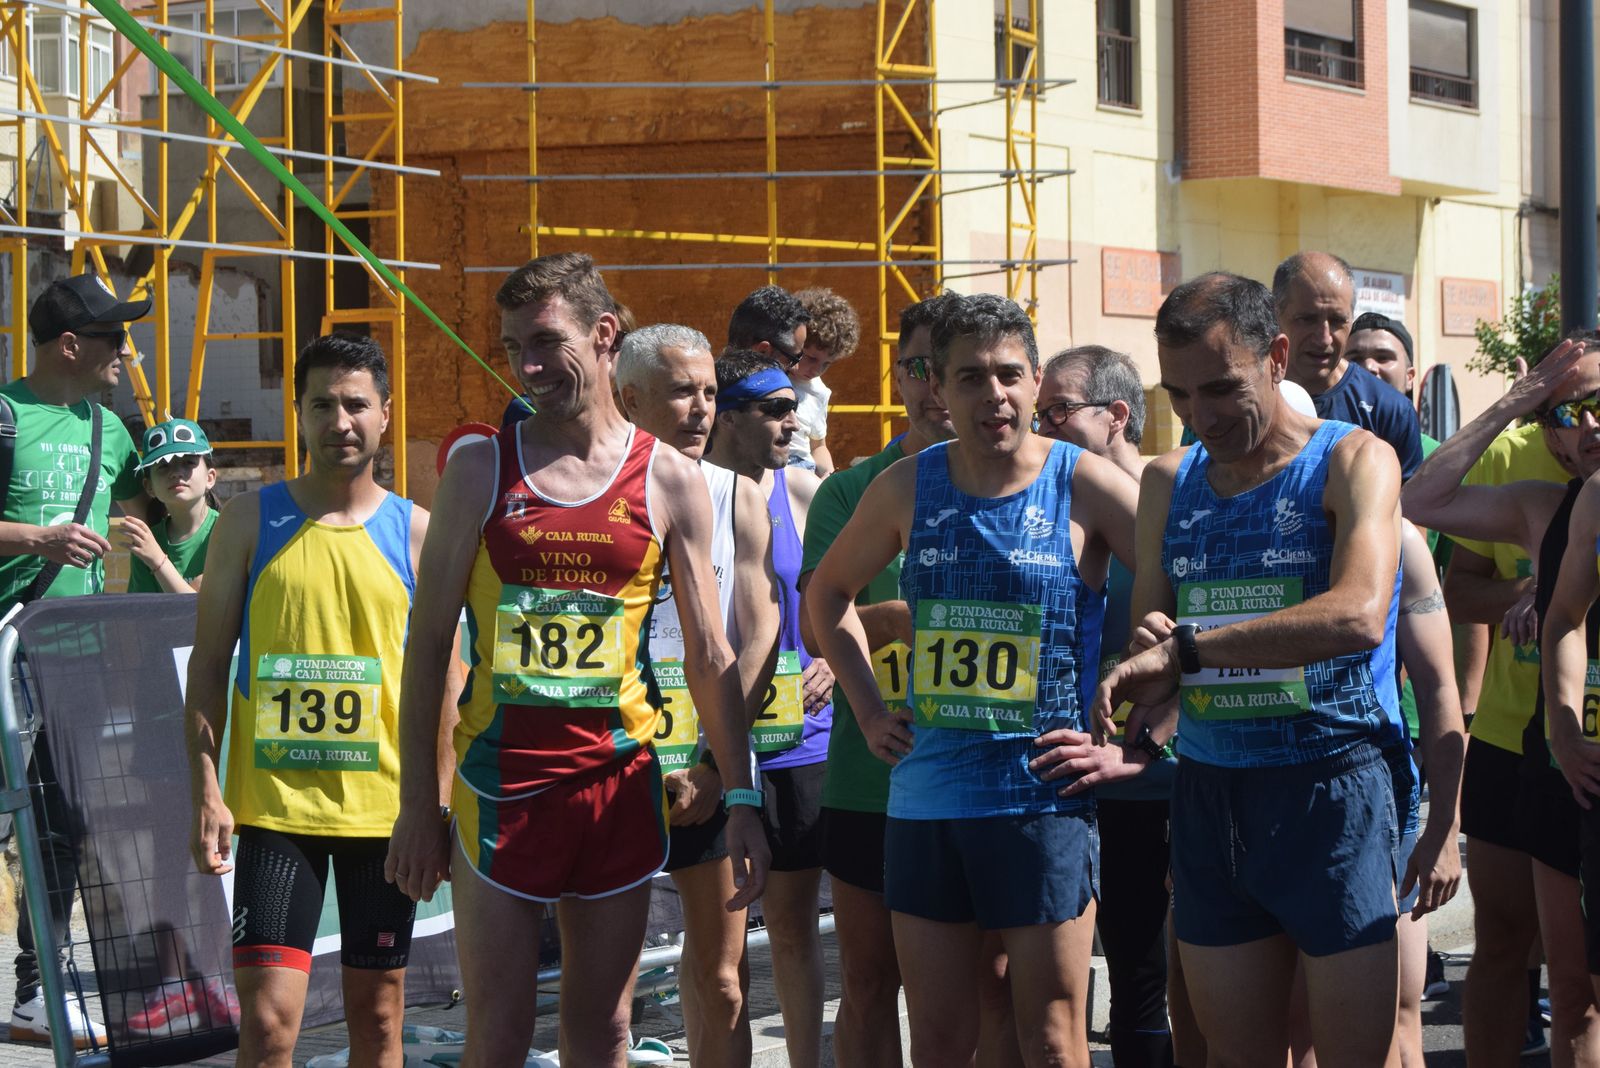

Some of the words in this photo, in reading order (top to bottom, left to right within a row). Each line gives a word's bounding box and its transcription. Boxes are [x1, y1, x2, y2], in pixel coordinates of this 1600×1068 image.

[40, 441, 53, 452] VII
[25, 471, 107, 492] CERO
[42, 490, 56, 500] DE
[545, 531, 574, 542] CAJA
[576, 531, 614, 544] RURAL
[539, 551, 592, 567] VINO
[521, 567, 547, 582] DE
[550, 568, 607, 585] TORO
[1210, 584, 1285, 598] FUNDACION
[538, 592, 607, 605] FUNDACION
[1211, 600, 1239, 611] CAJA
[1241, 597, 1285, 610] RURAL
[535, 602, 565, 613] CAJA
[566, 602, 607, 613] RURAL
[950, 605, 1024, 621] FUNDACION
[949, 617, 977, 629] CAJA
[979, 619, 1024, 632] RURAL
[511, 619, 605, 670] 182
[295, 659, 366, 671] FUNDACION
[927, 637, 1019, 691] 130
[295, 669, 322, 680] CAJA
[325, 670, 366, 681] RURAL
[881, 649, 911, 694] 1
[529, 684, 565, 698] CAJA
[568, 684, 617, 698] RURAL
[1214, 695, 1245, 708] CAJA
[1247, 691, 1300, 706] RURAL
[271, 687, 362, 735] 139
[940, 703, 970, 718] CAJA
[975, 707, 1024, 722] RURAL
[761, 732, 796, 744] RURAL
[289, 748, 322, 760] CAJA
[325, 750, 371, 762] RURAL
